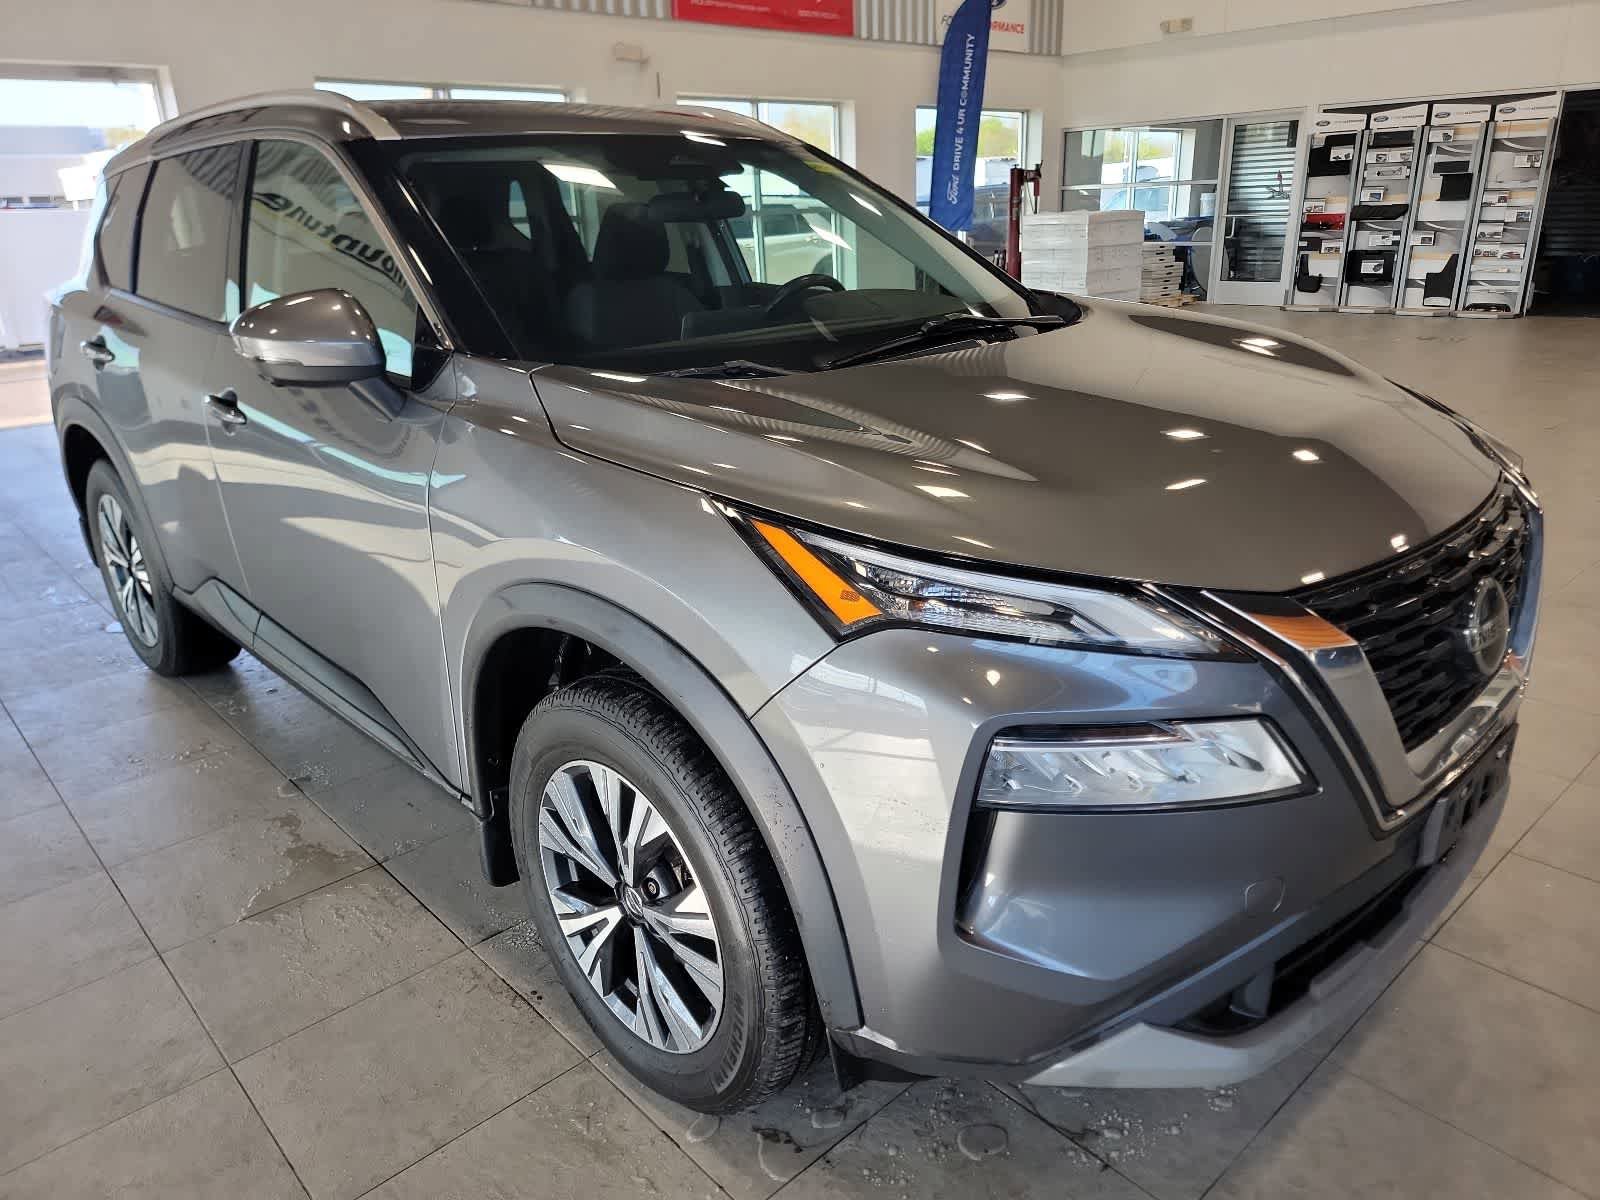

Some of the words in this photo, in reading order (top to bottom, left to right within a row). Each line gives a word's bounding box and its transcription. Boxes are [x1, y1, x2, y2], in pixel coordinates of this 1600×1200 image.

[960, 33, 975, 106] COMMUNITY
[957, 109, 967, 125] UR
[952, 136, 964, 171] DRIVE
[946, 174, 960, 205] Ford
